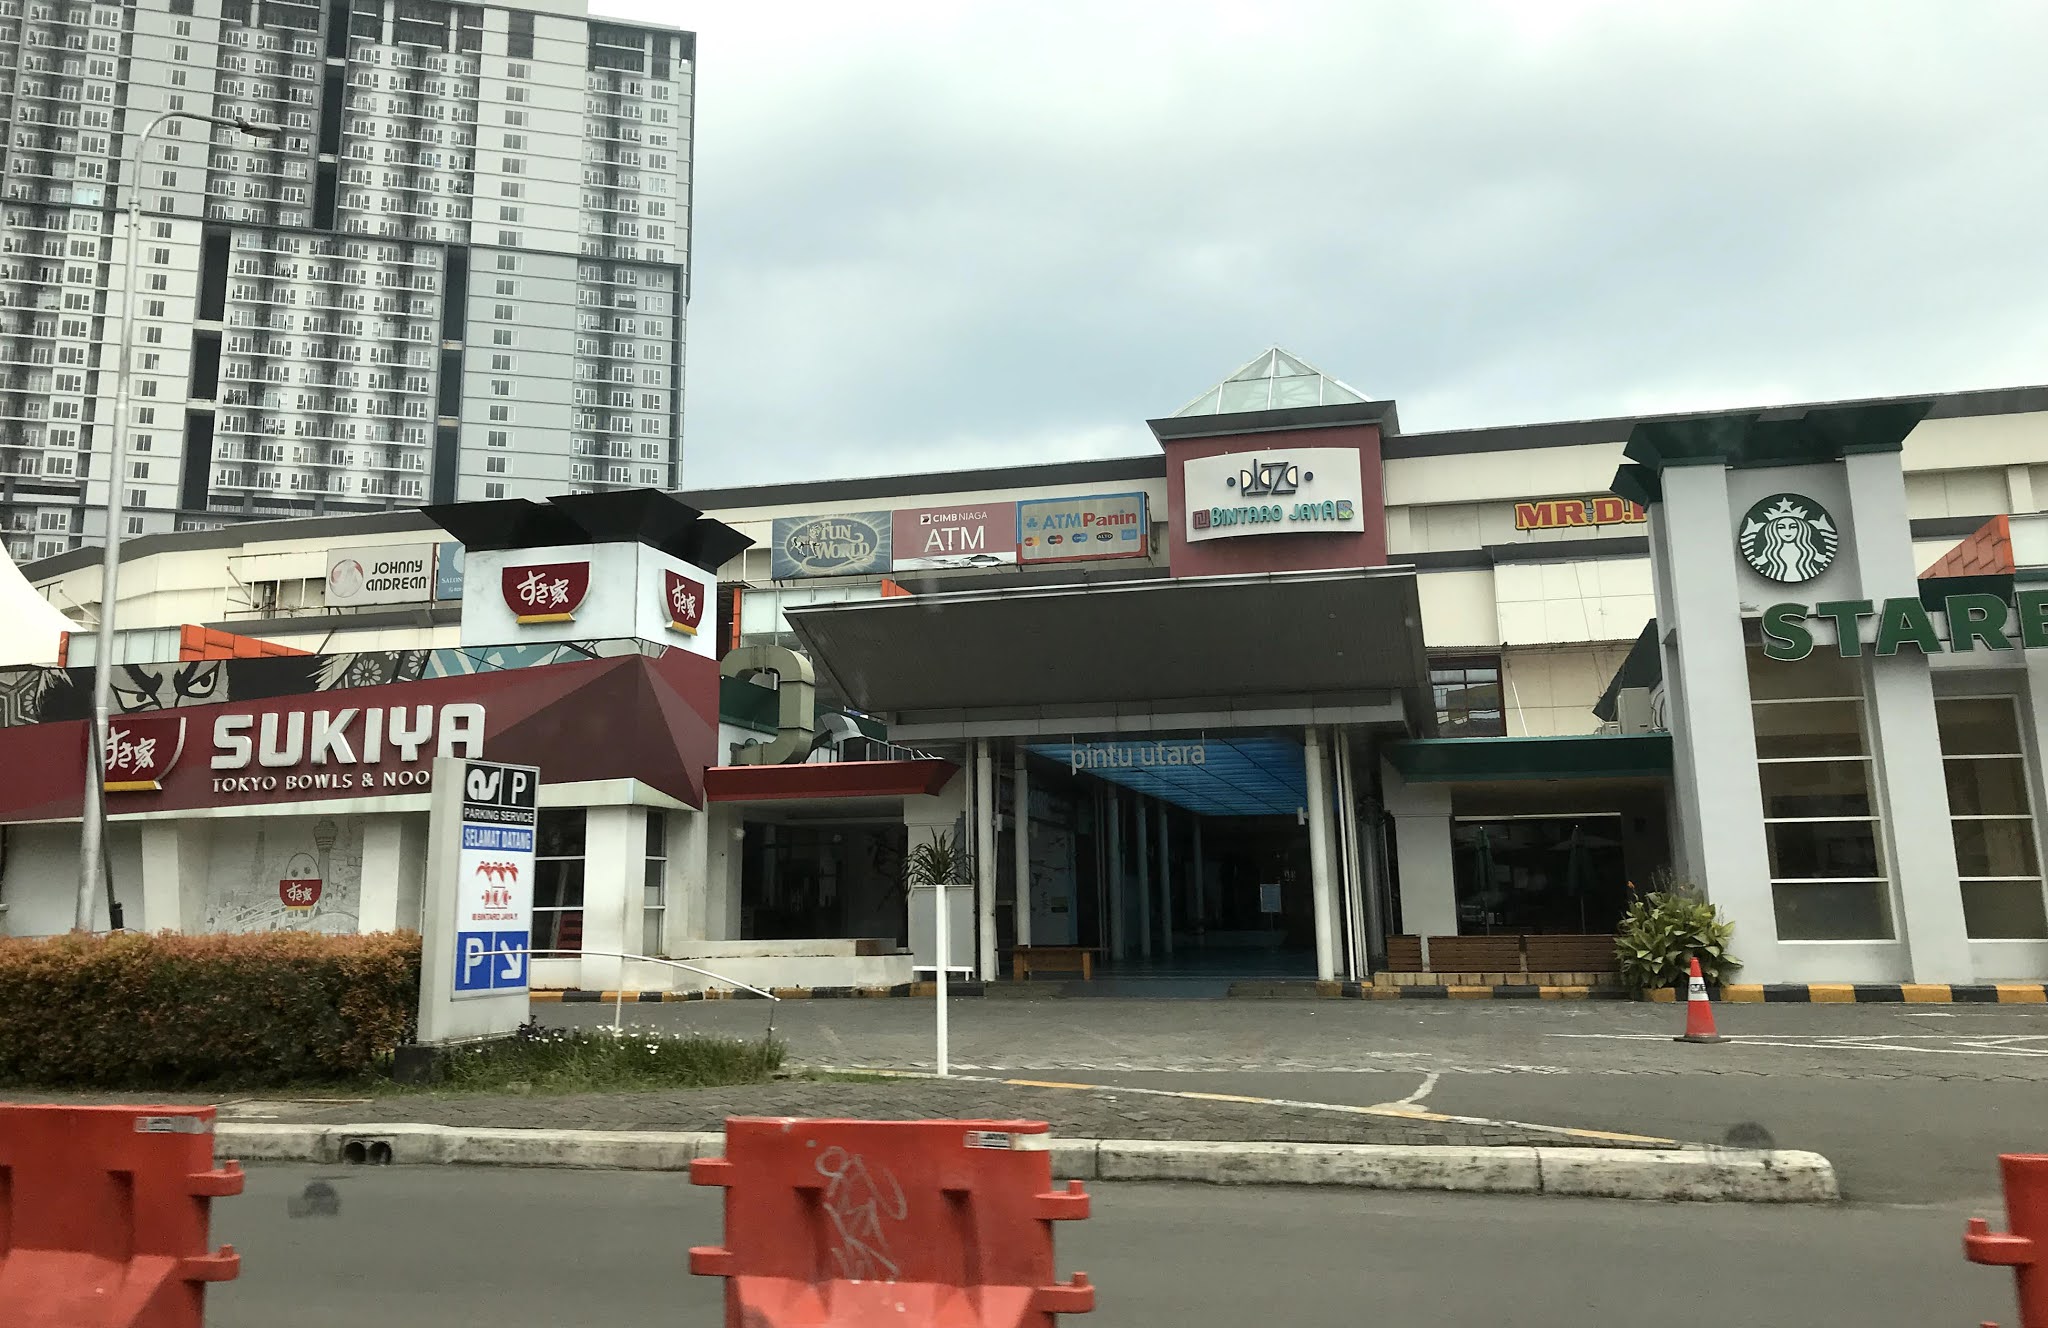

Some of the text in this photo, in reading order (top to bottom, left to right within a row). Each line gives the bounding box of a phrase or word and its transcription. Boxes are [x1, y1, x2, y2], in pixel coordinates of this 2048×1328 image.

[1240, 458, 1299, 497] plaza
[933, 511, 988, 523] CIMB NIAGA
[1211, 504, 1283, 528] BINTARO
[1289, 500, 1336, 521] JAYA
[924, 525, 985, 553] ATM
[516, 570, 569, 609] すき家
[210, 703, 486, 770] SUKIYA
[1071, 742, 1206, 776] pintu utara
[212, 775, 277, 793] TOKYO
[285, 773, 353, 790] BOWLS
[361, 772, 375, 788] &
[511, 771, 527, 804] P
[464, 807, 534, 823] PARKING SERVICE
[465, 828, 532, 850] SELAMAT DATANG
[464, 937, 485, 984] P
